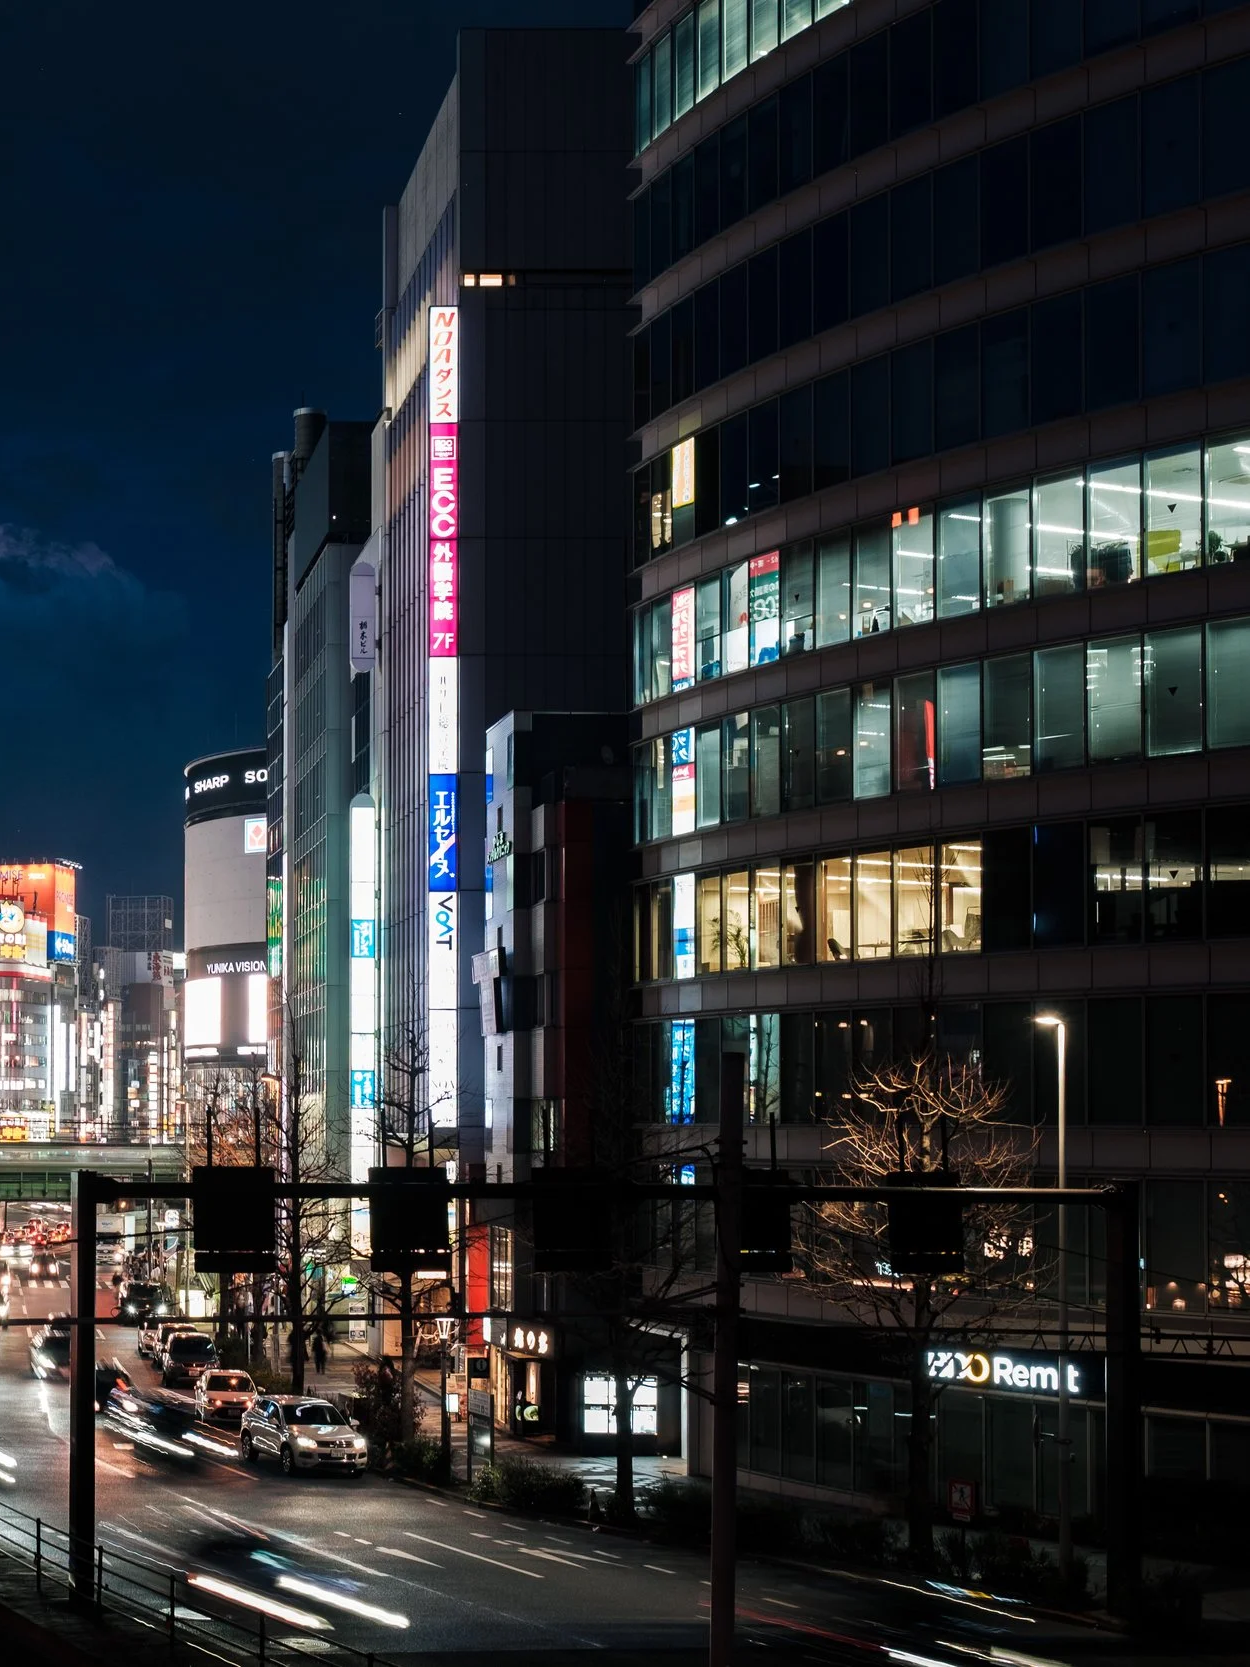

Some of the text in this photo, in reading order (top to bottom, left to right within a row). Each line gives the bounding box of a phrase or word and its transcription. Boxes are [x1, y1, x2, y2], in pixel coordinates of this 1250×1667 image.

[432, 467, 456, 538] ECC
[433, 632, 455, 650] 7F
[194, 774, 230, 794] SHARP
[206, 960, 267, 975] YUNIKA VISION
[993, 1356, 1080, 1393] Remt
